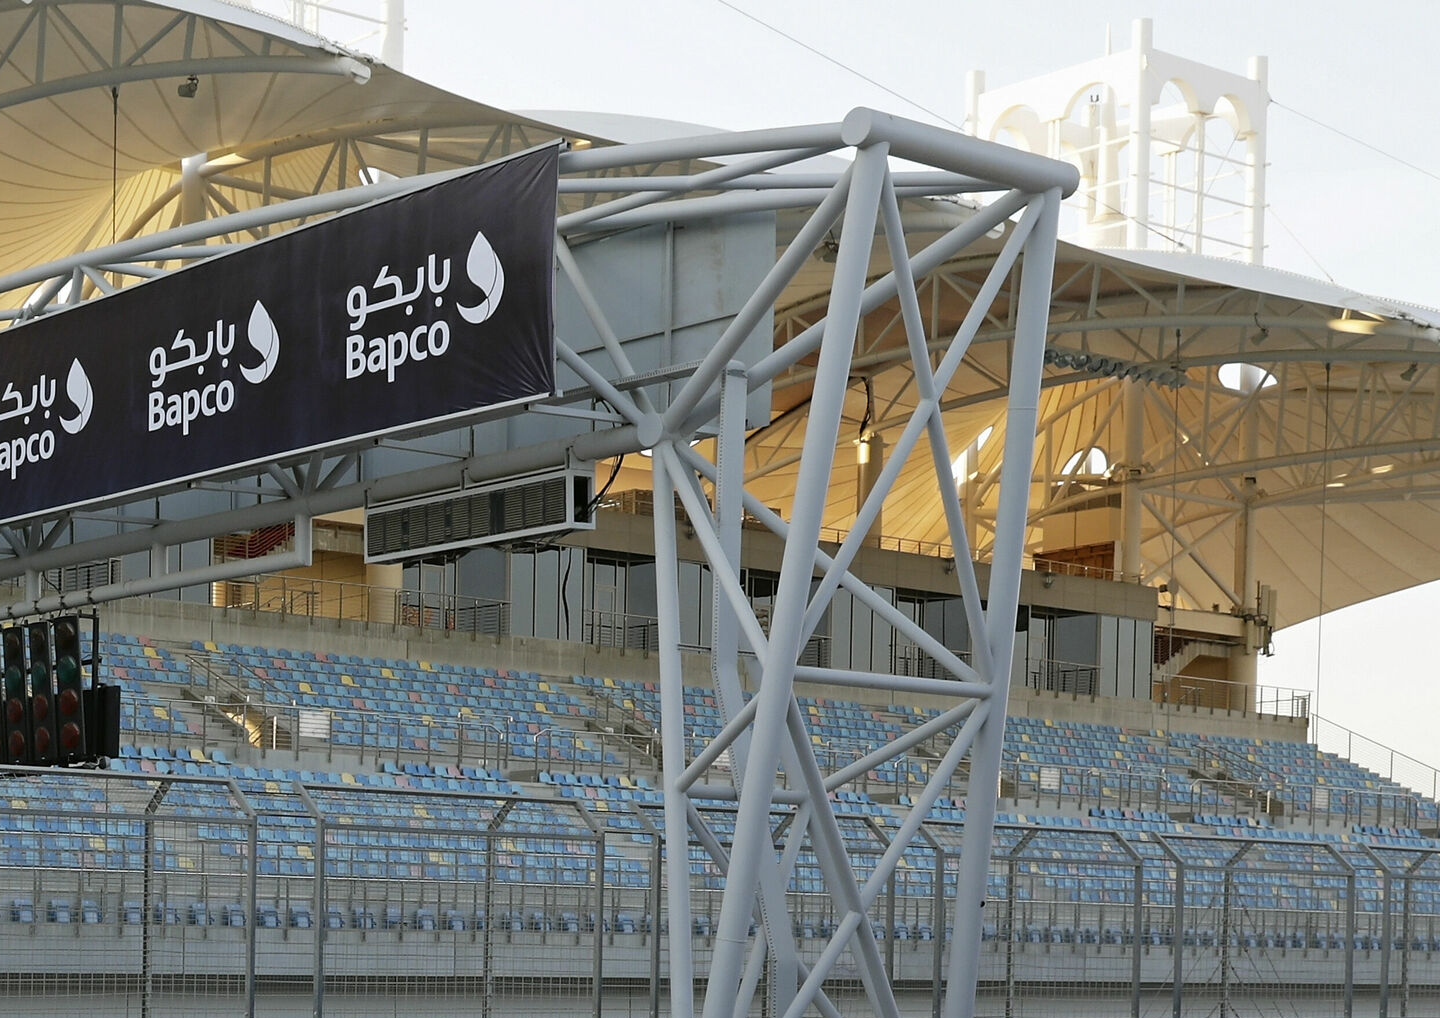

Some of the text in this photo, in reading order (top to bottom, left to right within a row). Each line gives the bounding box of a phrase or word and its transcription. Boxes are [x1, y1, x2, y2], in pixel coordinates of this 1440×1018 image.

[346, 253, 451, 331] بابكو
[149, 319, 236, 387] بابكو
[345, 320, 450, 383] Bapco
[148, 379, 234, 436] Bapco
